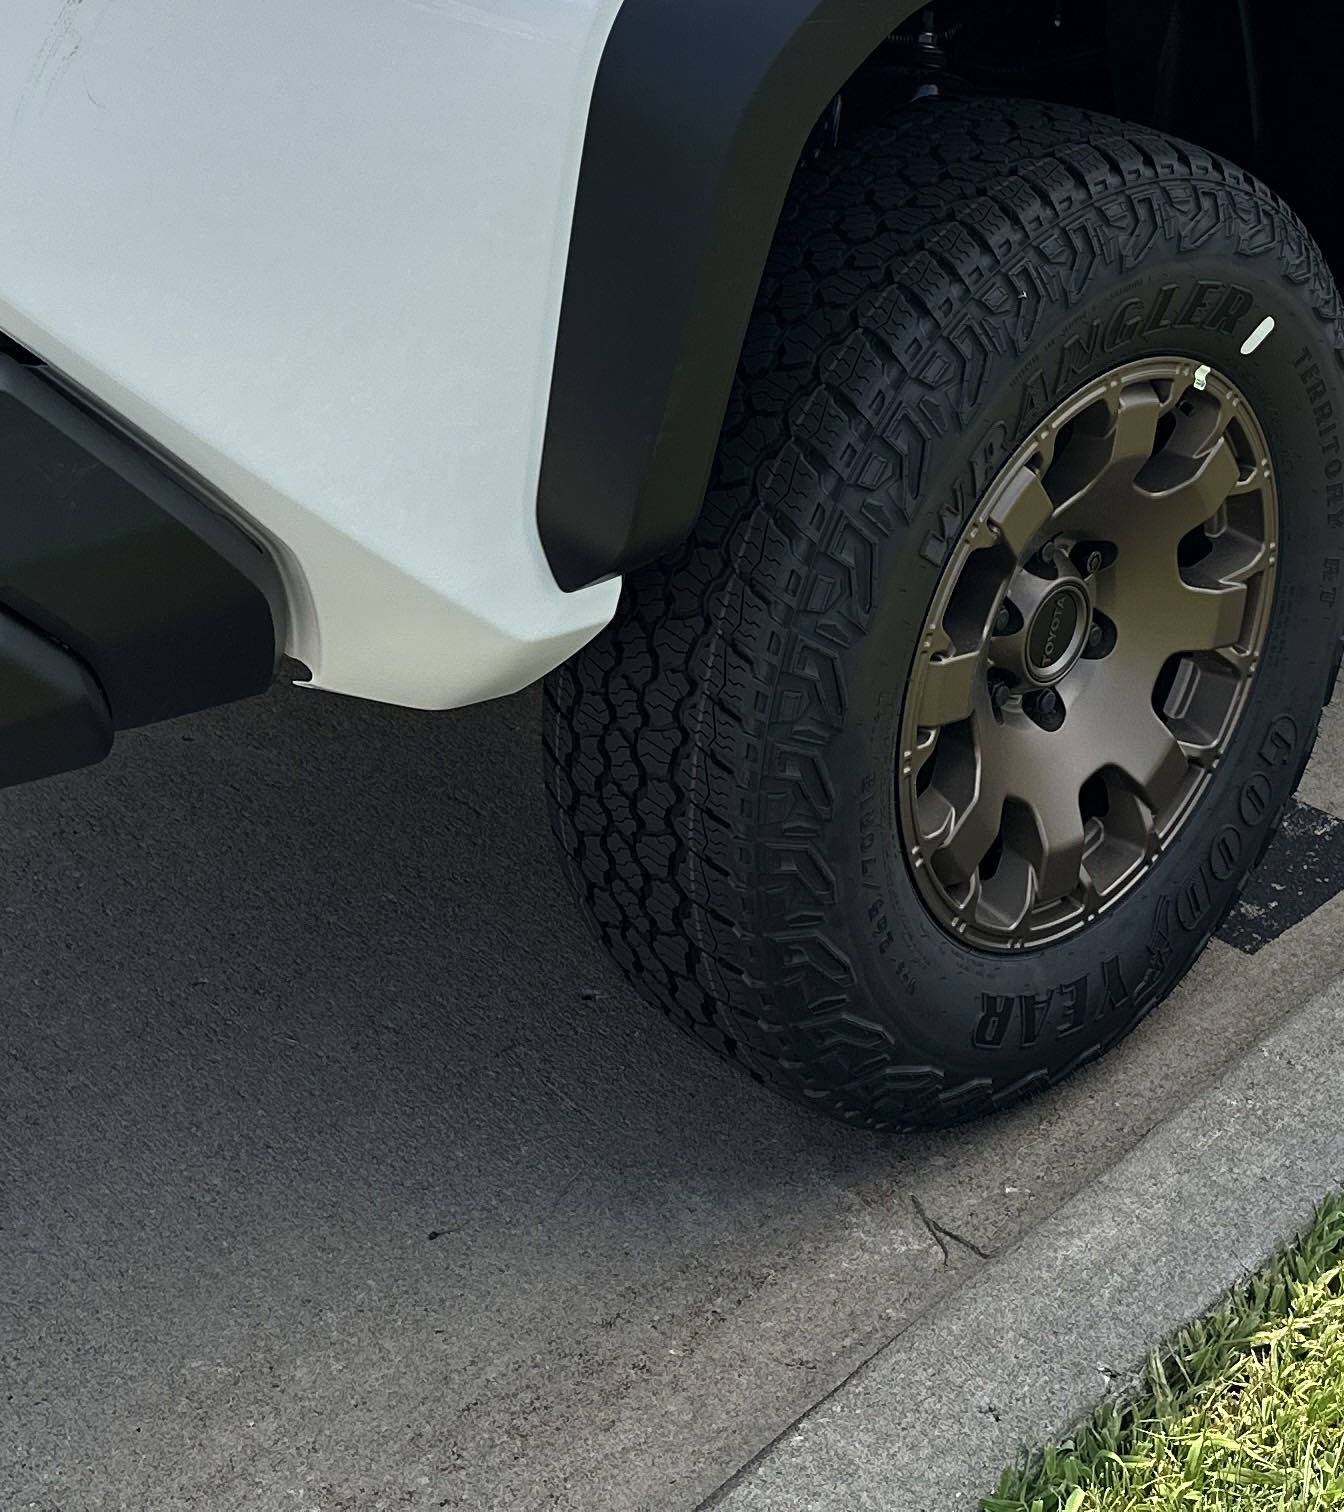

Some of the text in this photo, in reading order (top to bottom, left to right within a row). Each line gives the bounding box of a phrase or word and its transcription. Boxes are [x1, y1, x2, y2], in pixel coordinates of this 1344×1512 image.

[918, 279, 1257, 567] WRANGLER
[1292, 345, 1344, 530] TERRITORY
[1041, 596, 1067, 667] TOYOTA
